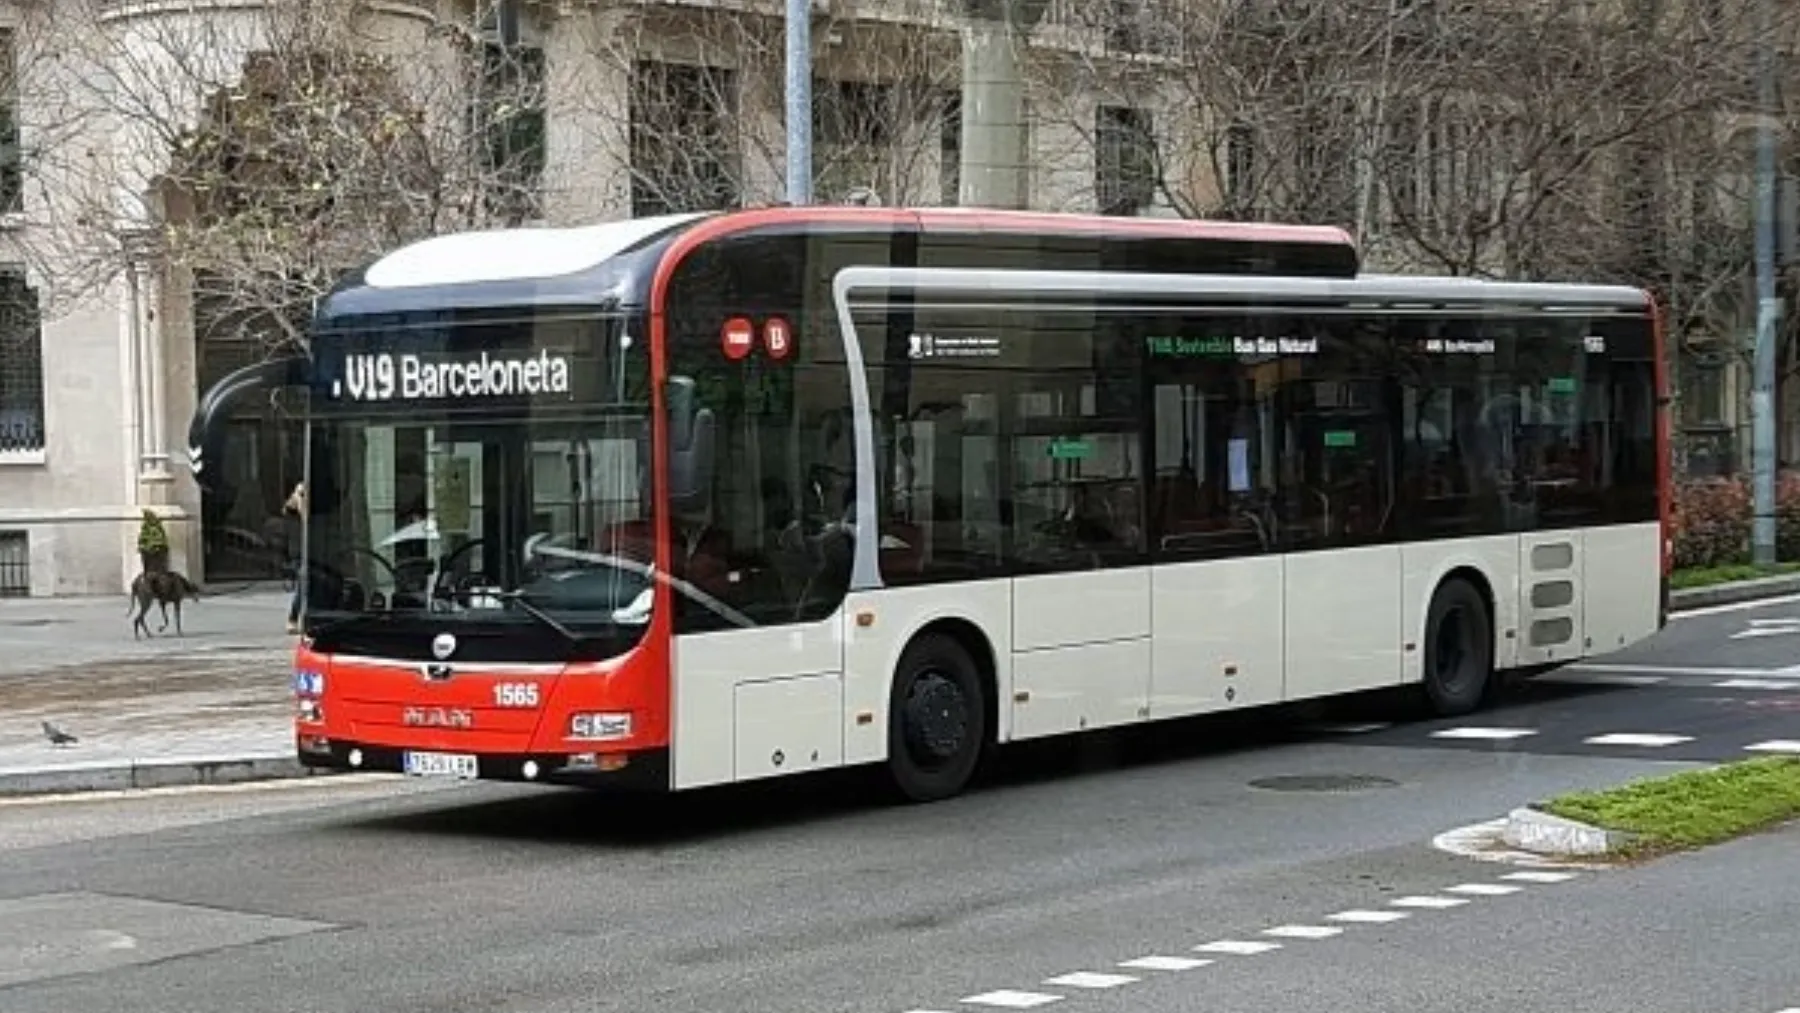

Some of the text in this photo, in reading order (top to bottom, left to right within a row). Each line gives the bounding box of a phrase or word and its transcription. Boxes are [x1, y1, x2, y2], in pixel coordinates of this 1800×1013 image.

[345, 348, 569, 400] V19 Barceloneta
[492, 682, 540, 706] 1565
